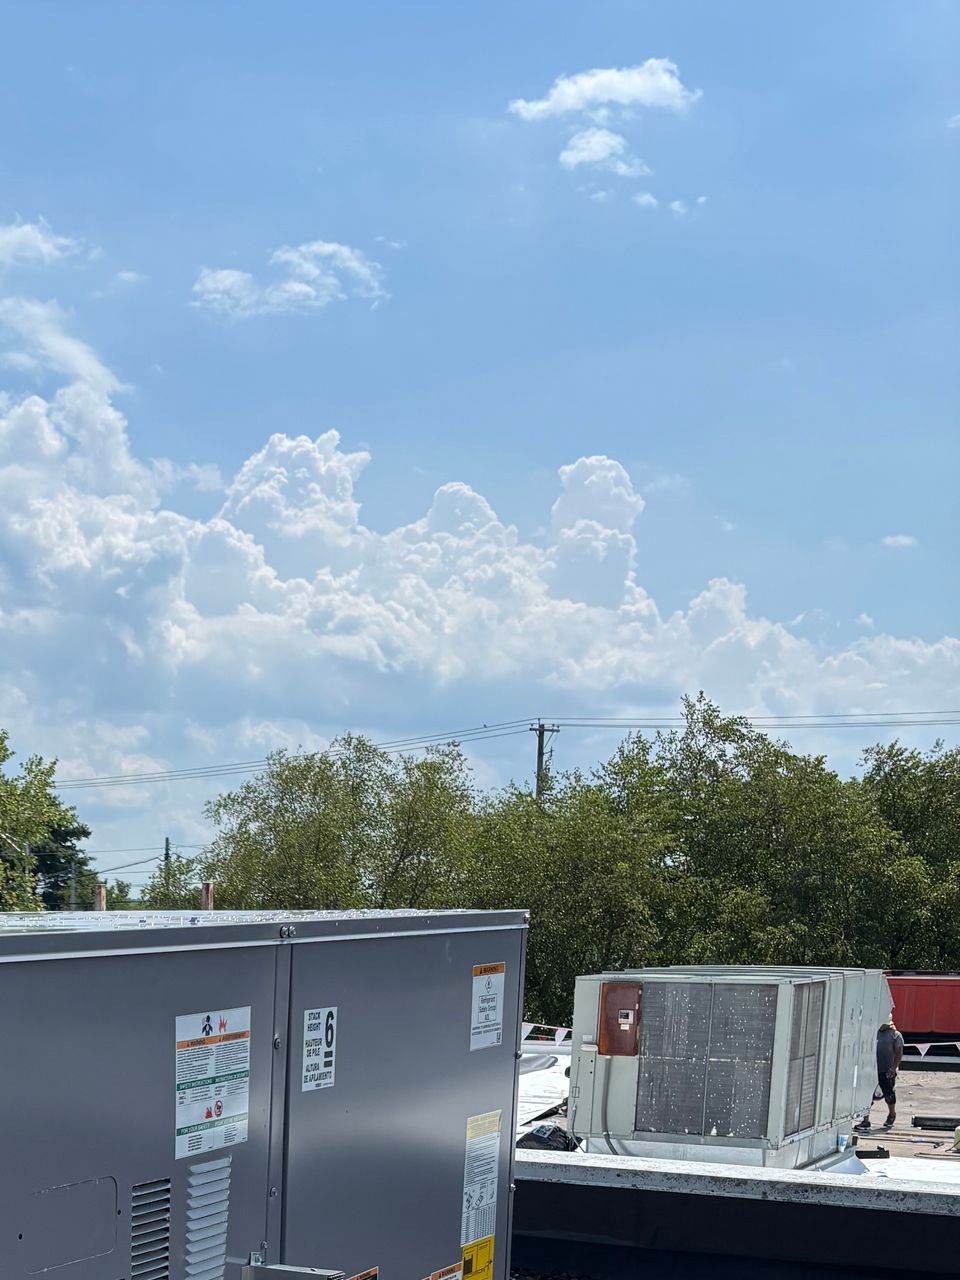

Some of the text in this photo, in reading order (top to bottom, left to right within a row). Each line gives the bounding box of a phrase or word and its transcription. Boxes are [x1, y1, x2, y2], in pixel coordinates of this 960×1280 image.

[308, 1012, 320, 1021] STACK
[307, 1022, 321, 1032] HEIGHT
[325, 1010, 334, 1048] 6
[305, 1038, 322, 1048] HAUTEUR
[305, 1062, 320, 1072] ALTURA
